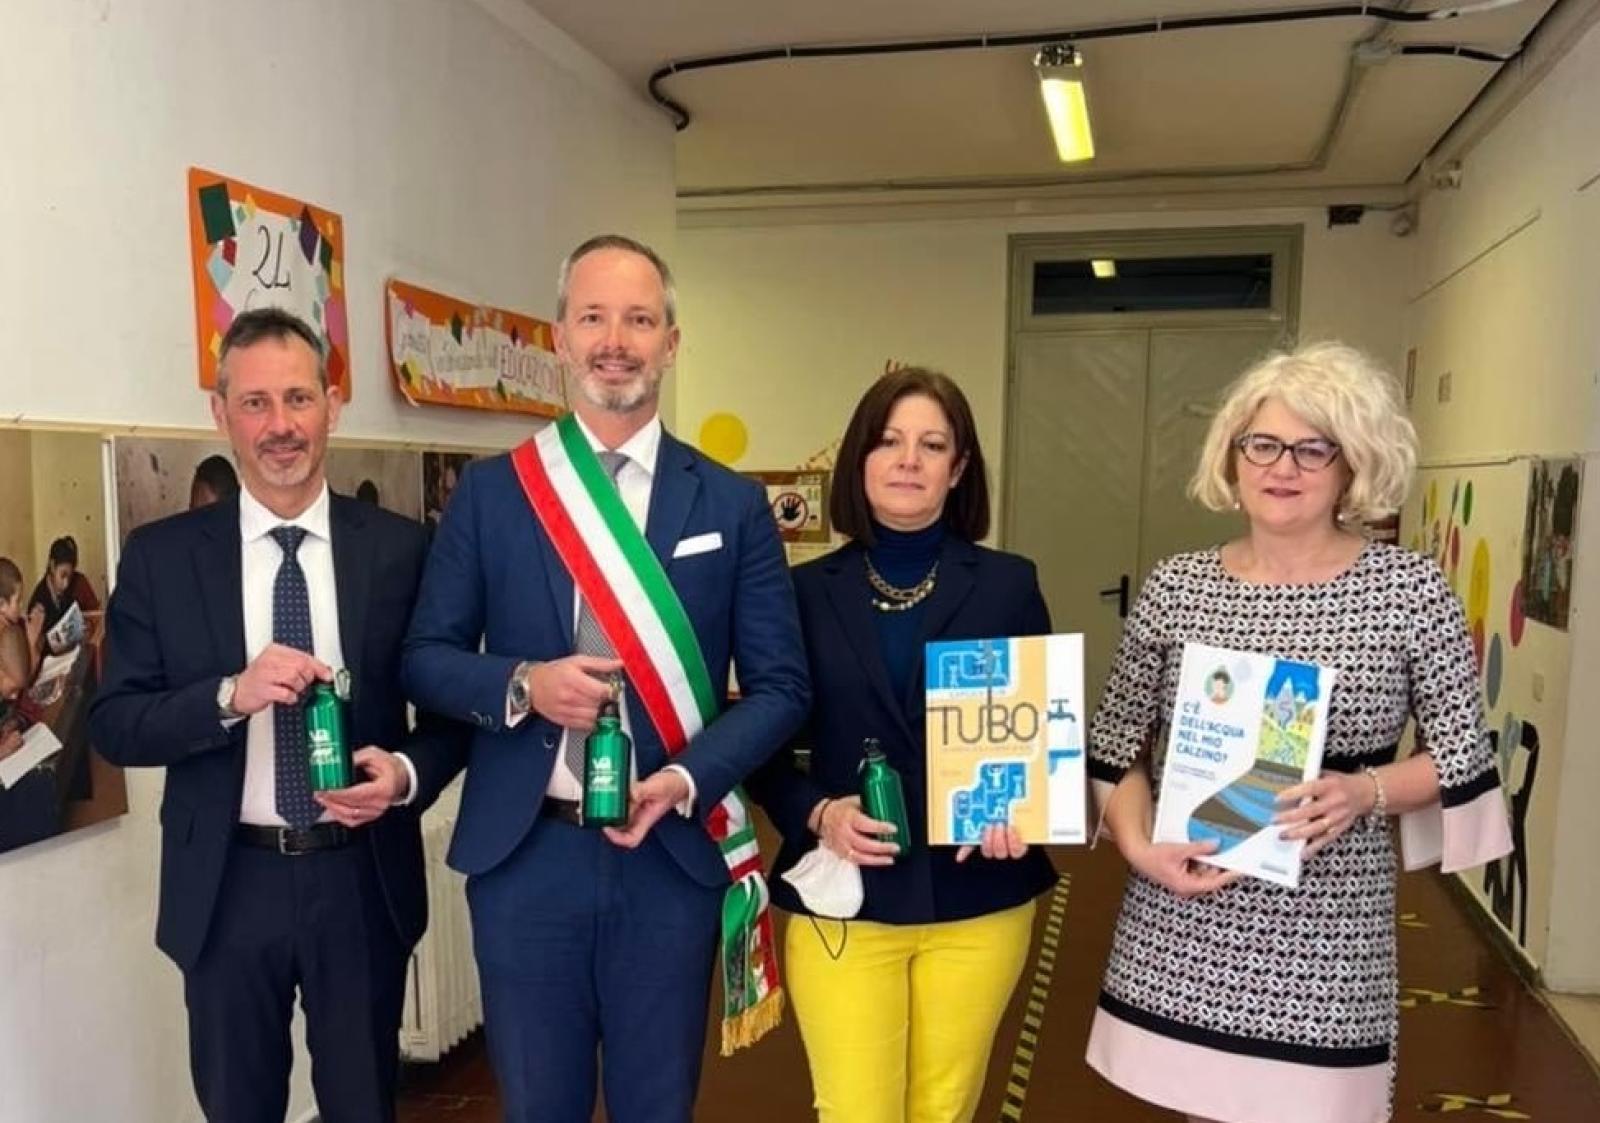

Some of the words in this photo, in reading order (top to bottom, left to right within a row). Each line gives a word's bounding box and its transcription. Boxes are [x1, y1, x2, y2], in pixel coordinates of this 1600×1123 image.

[926, 701, 1039, 746] TUBO
[1180, 714, 1245, 739] DELL'ACQUA
[1178, 729, 1198, 744] NEL
[1201, 734, 1223, 749] MIO
[1175, 742, 1228, 763] CALZINO?
